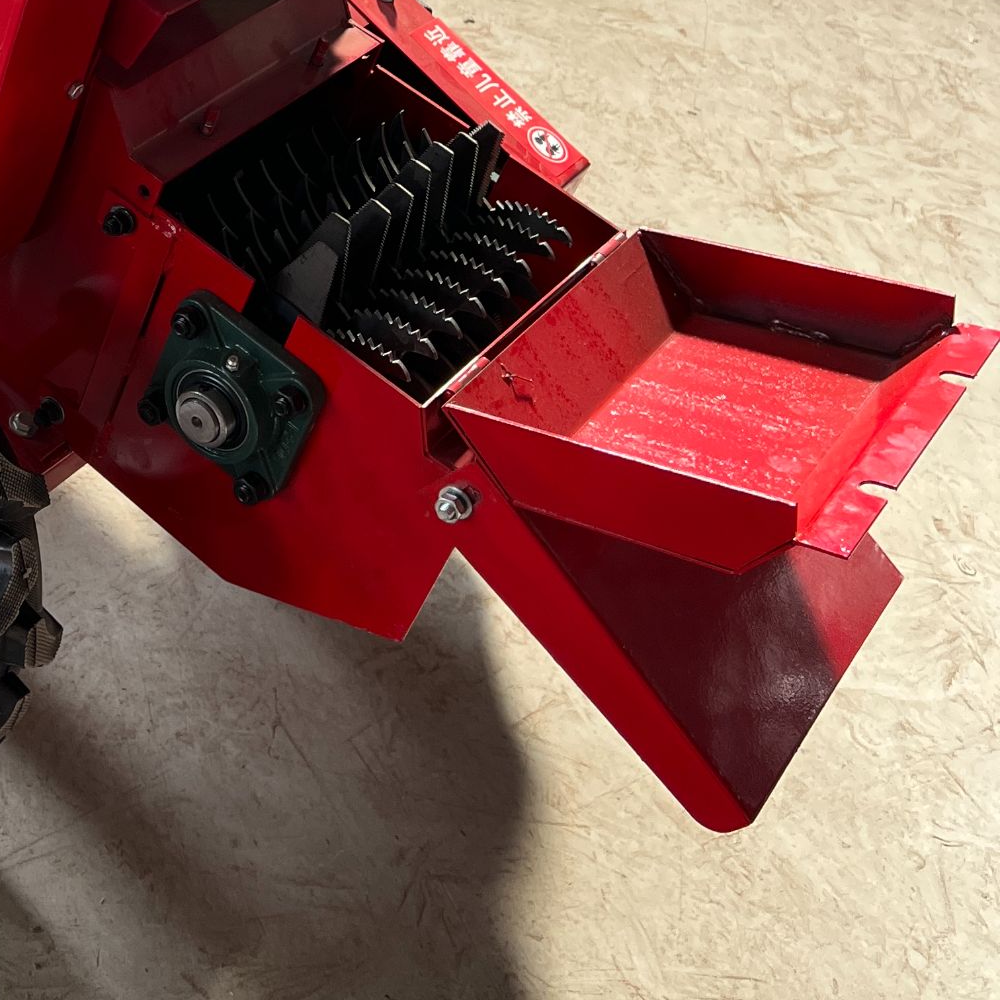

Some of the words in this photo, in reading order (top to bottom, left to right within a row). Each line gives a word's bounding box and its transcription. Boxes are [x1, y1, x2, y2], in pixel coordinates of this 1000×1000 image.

[423, 24, 533, 129] 禁止儿童靠近
